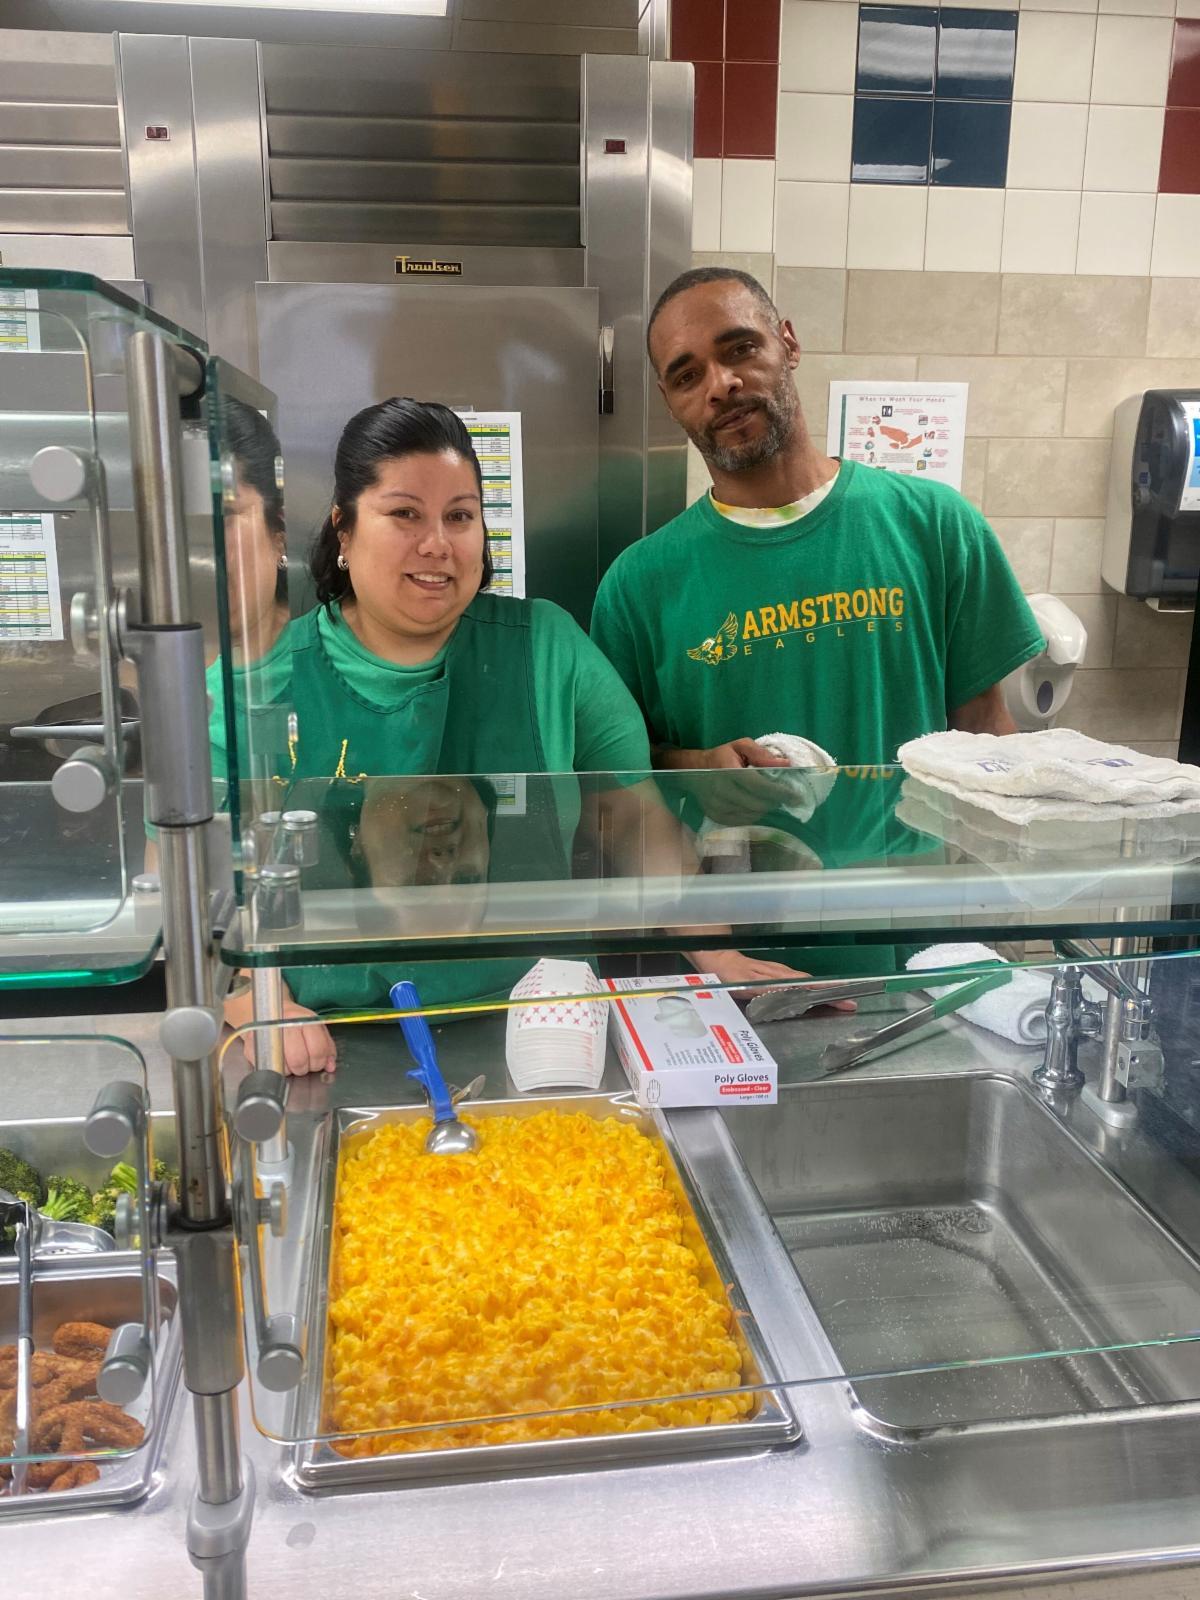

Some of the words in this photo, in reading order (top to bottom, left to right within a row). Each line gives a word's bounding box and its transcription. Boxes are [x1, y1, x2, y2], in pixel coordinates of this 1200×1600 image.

[395, 255, 461, 273] Traulsen
[742, 588, 904, 640] ARMSTRONG
[743, 621, 904, 656] EAGLES
[738, 1029, 752, 1043] Poly
[747, 1042, 764, 1062] Gloves
[714, 1074, 735, 1084] Poly
[737, 1073, 769, 1083] Gloves
